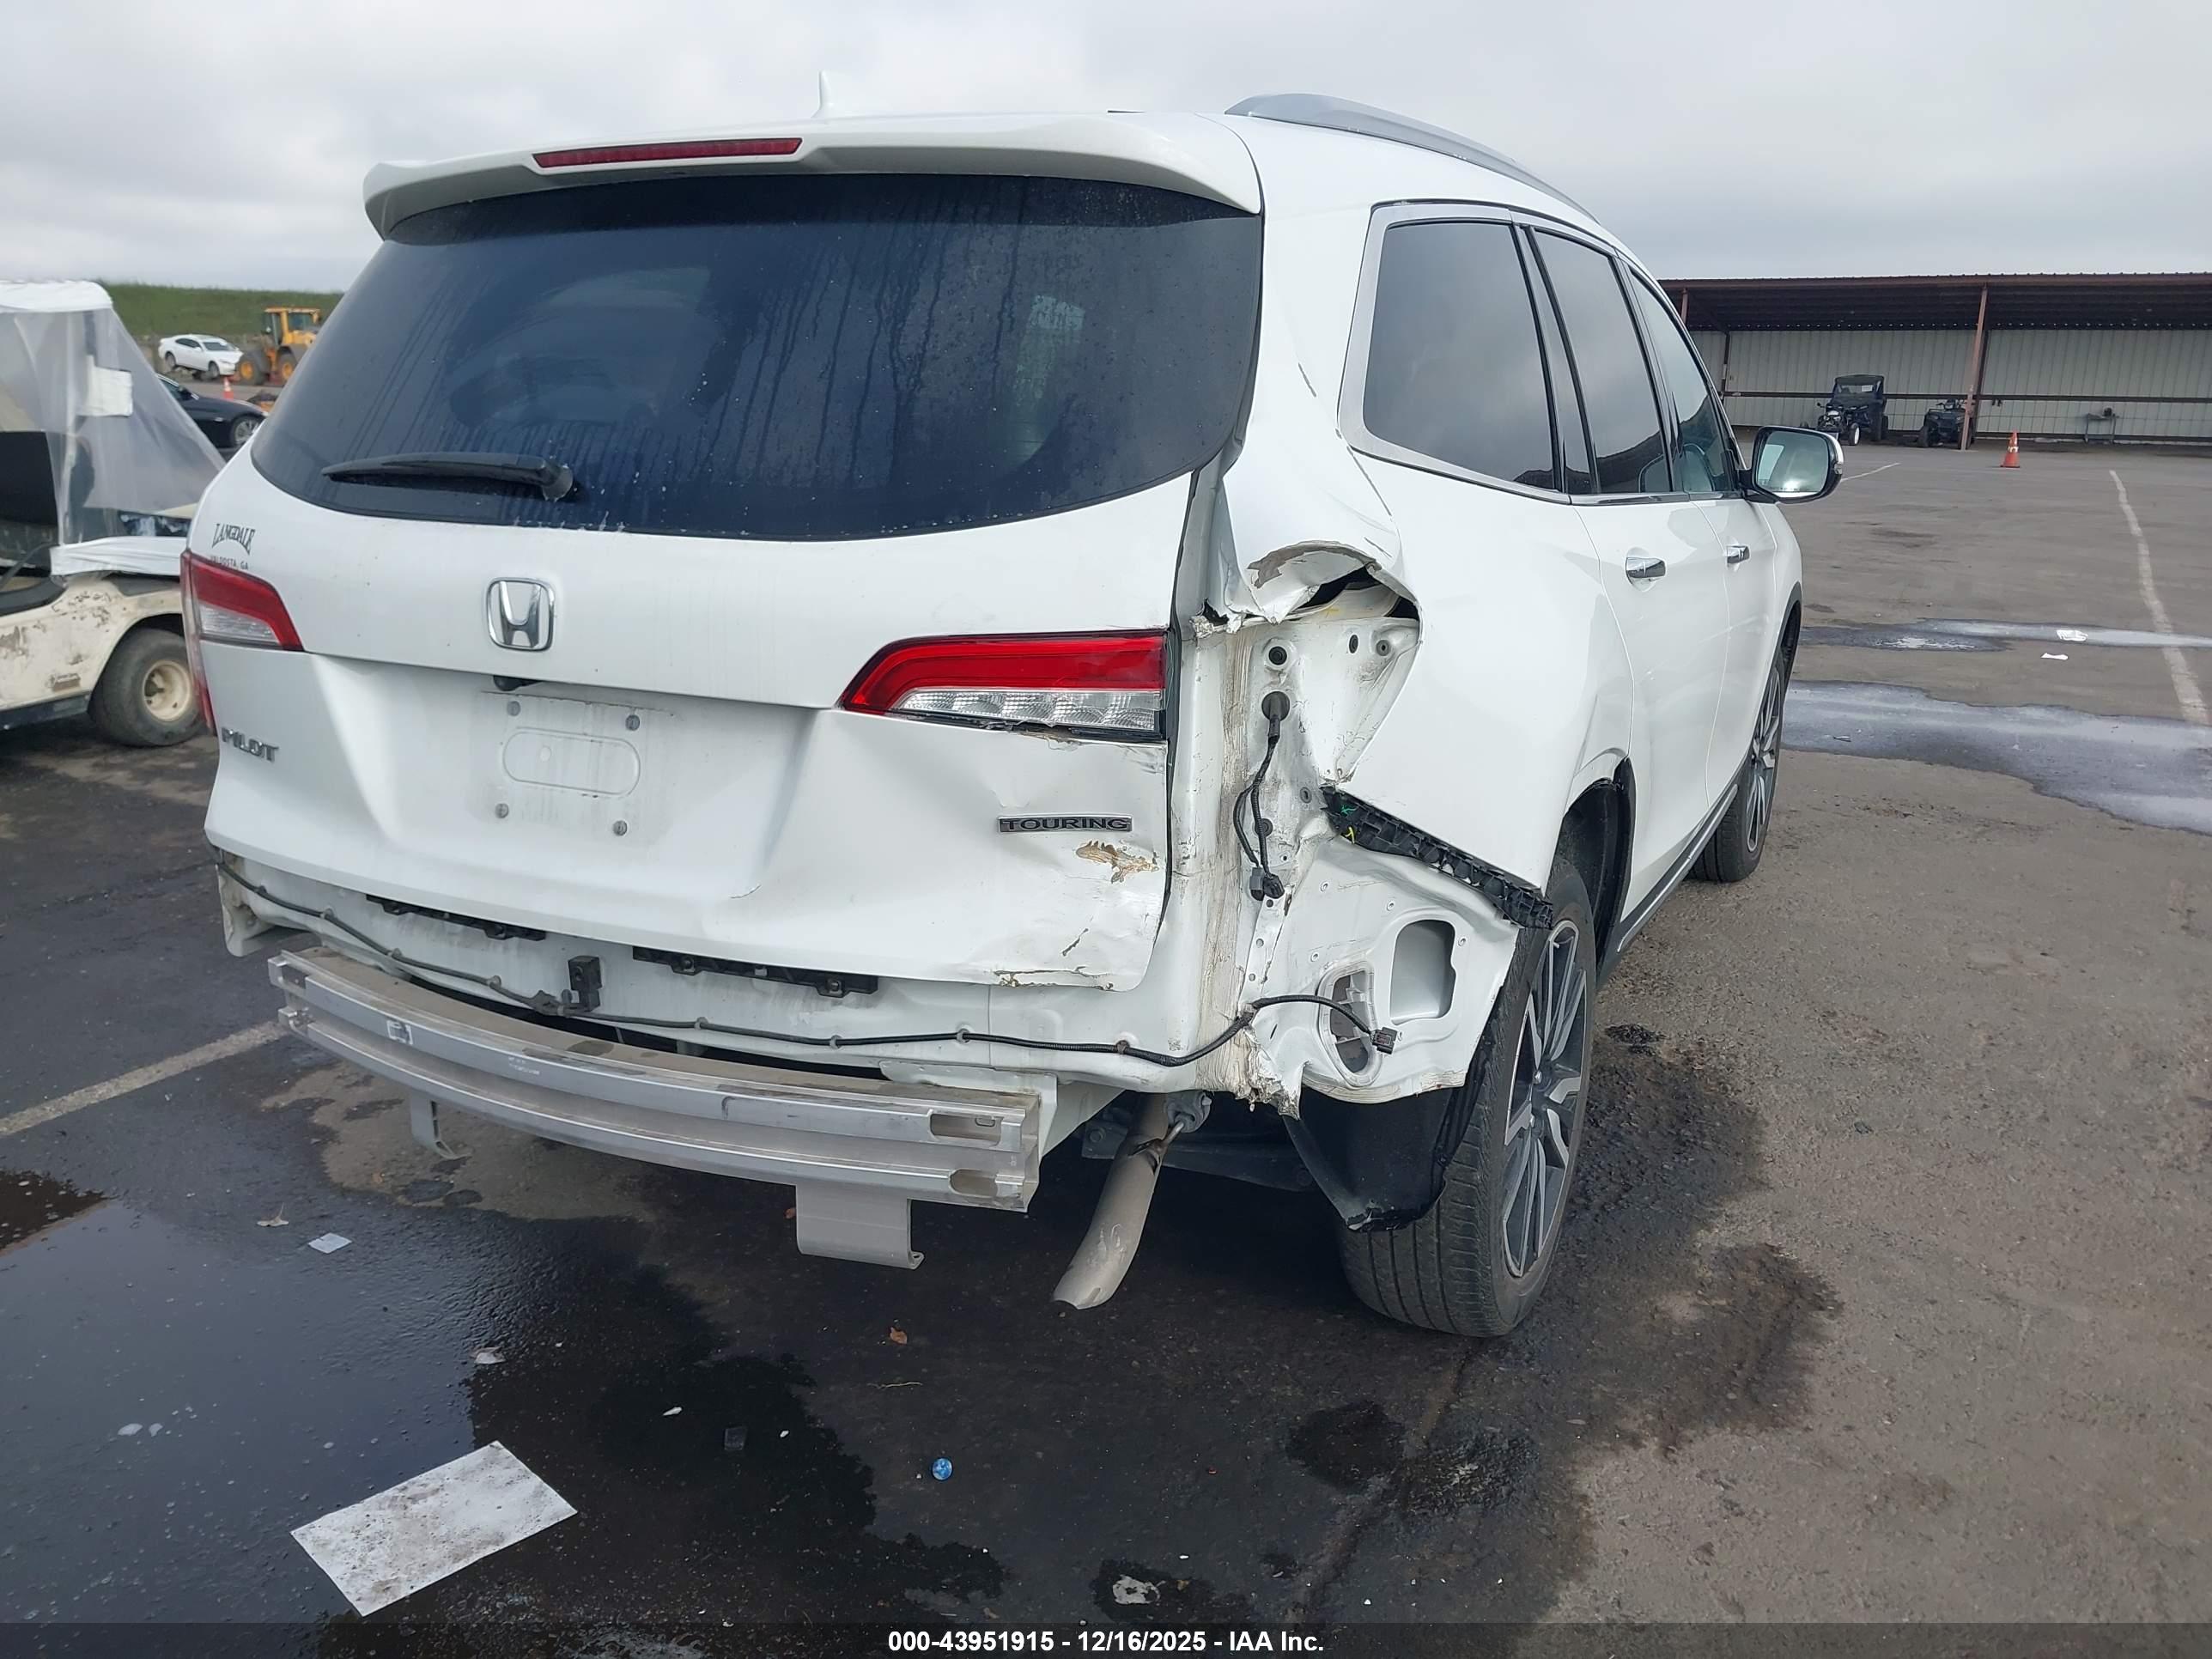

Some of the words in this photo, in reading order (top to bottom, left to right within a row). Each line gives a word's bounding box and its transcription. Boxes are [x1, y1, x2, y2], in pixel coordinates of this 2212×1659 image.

[212, 523, 255, 555] LANGDALE
[222, 726, 279, 763] PILOT
[1001, 817, 1131, 831] TOURING
